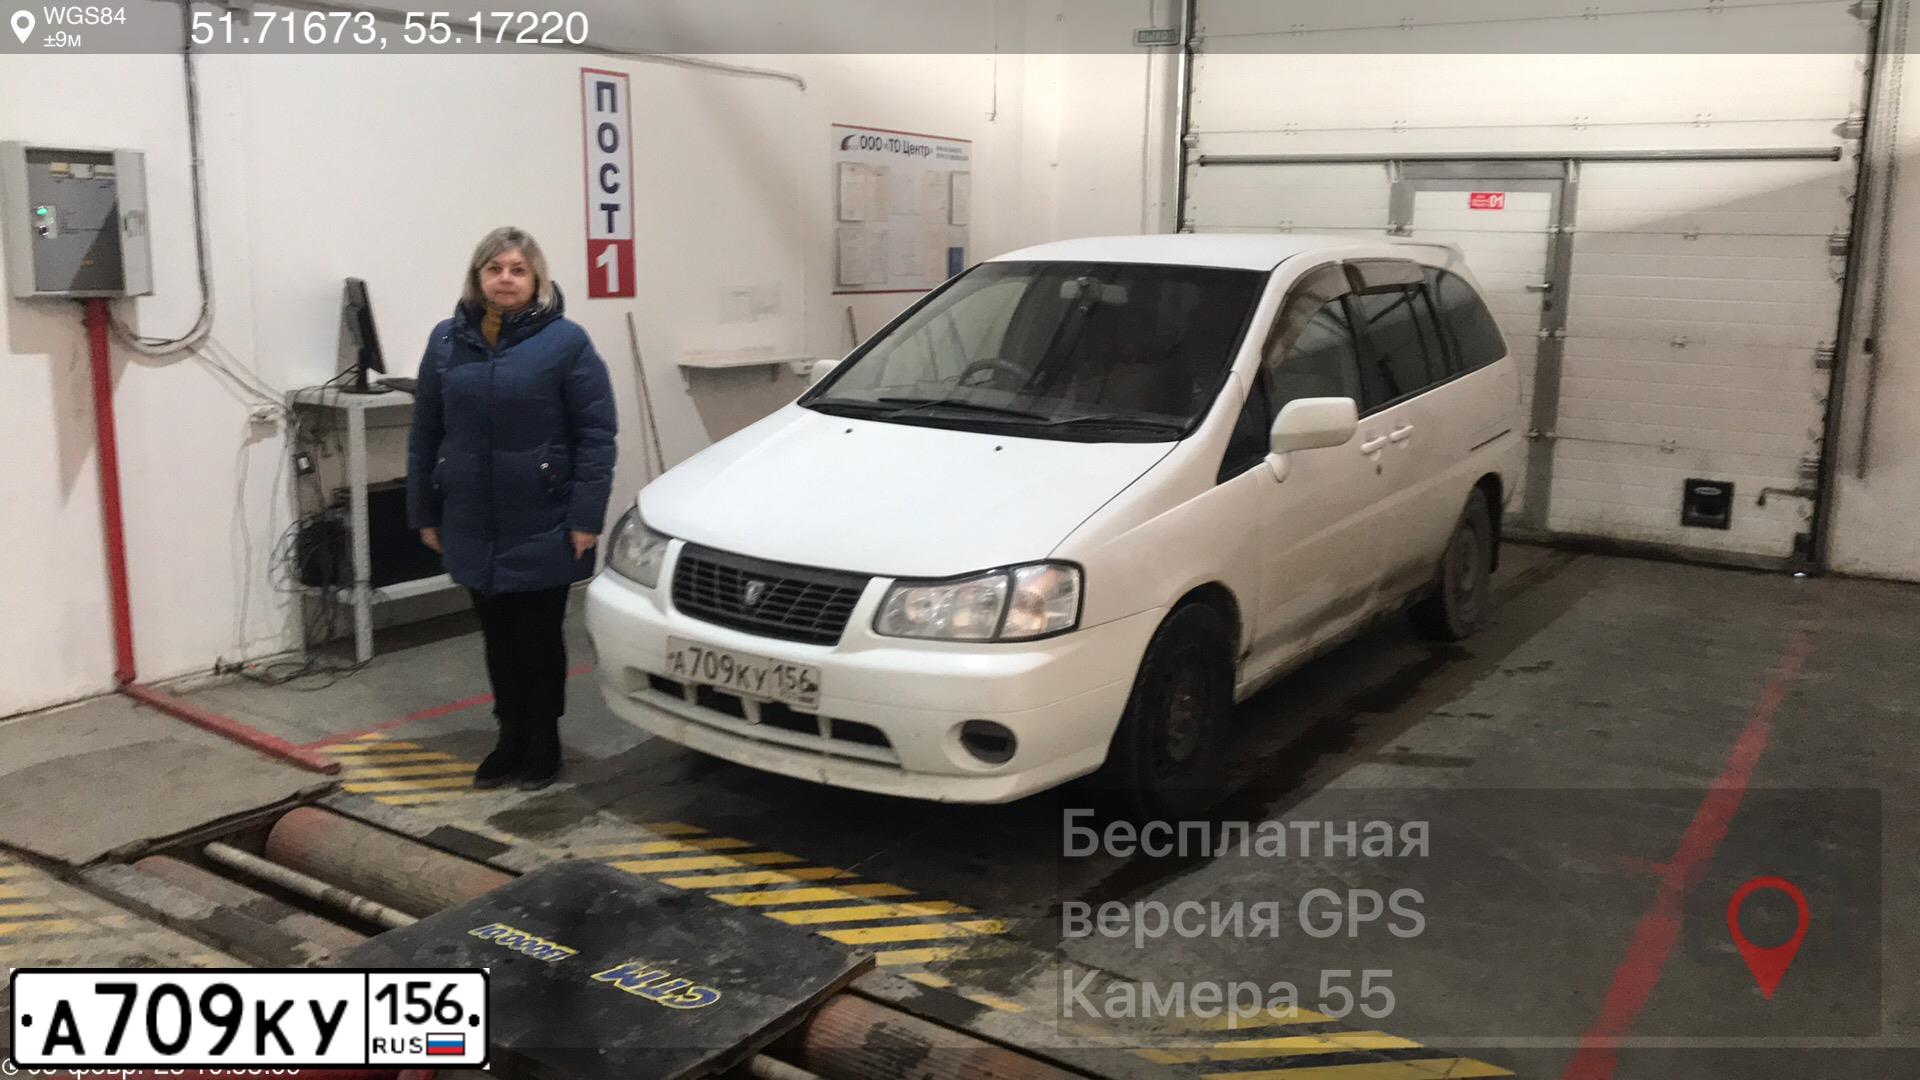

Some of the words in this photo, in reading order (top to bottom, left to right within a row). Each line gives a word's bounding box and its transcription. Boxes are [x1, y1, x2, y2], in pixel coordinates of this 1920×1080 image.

[596, 80, 621, 234] ПОСТ
[860, 135, 883, 152] ООО
[595, 243, 620, 294] 1
[672, 646, 768, 692] А709КУ
[773, 664, 814, 693] 156
